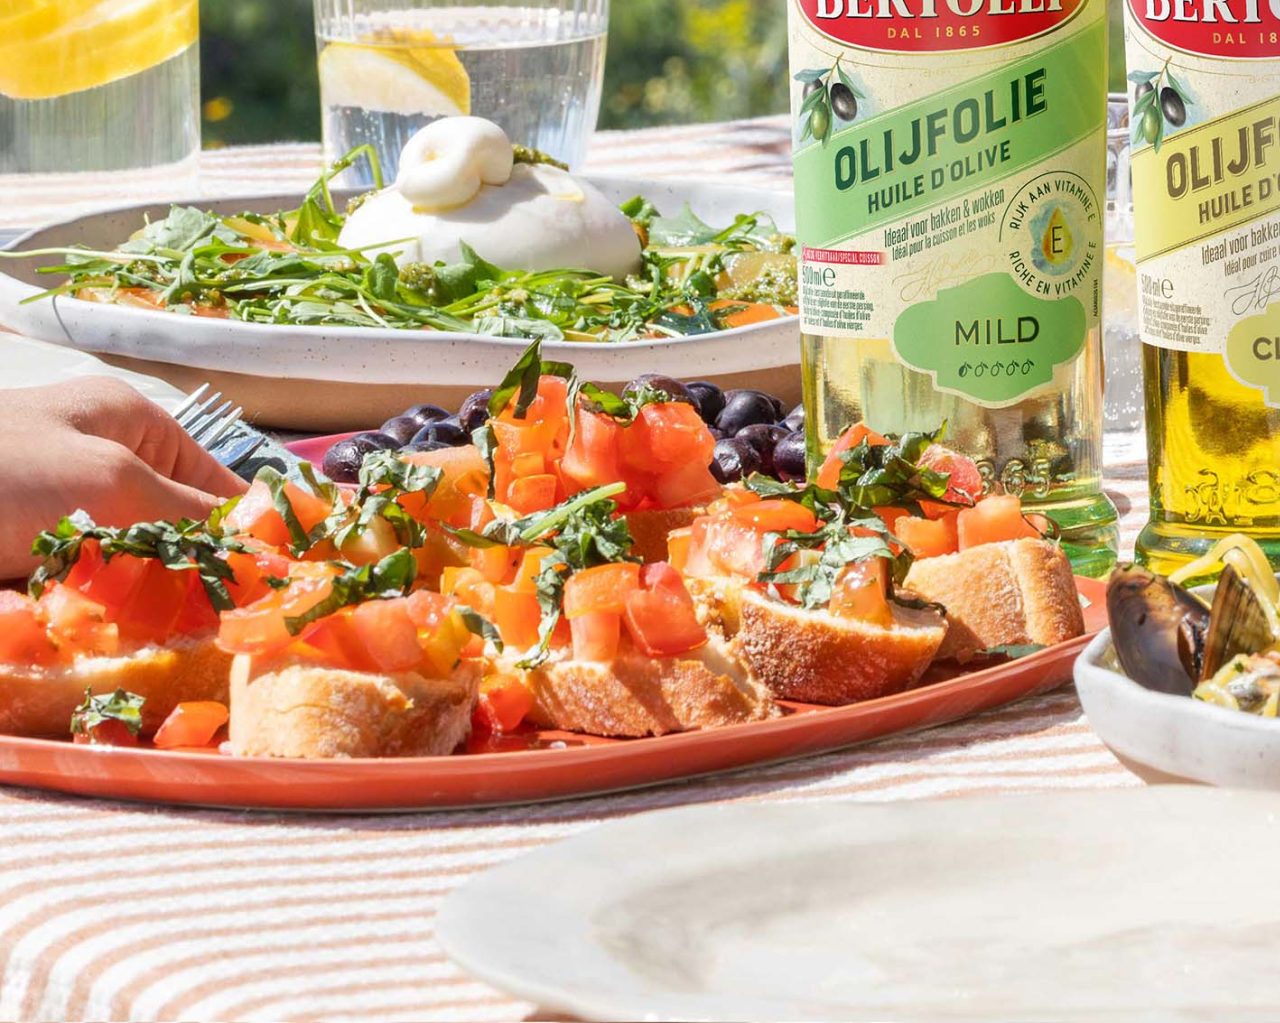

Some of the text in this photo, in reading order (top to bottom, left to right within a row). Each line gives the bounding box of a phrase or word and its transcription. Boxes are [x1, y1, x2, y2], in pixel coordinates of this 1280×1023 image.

[887, 25, 981, 39] DAL 1865
[1212, 32, 1247, 45] DAL
[834, 67, 1047, 191] OLIJFOLIE
[868, 140, 1011, 214] HUILE D'OLIVE
[884, 223, 909, 248] Ideaal
[910, 218, 929, 238] voor
[930, 206, 961, 231] bakken
[972, 188, 1005, 215] wokken
[1009, 201, 1029, 230] RIJK
[1028, 182, 1052, 203] AAN
[1054, 179, 1092, 213] VITAMINE
[1198, 184, 1253, 225] HUILE
[909, 239, 925, 256] pour
[978, 211, 996, 228] woks
[1052, 225, 1063, 254] E
[1201, 238, 1227, 265] Ideaal
[1229, 233, 1249, 255] voor
[1009, 250, 1036, 287] RICHE
[1036, 280, 1051, 295] EN
[1054, 252, 1095, 296] VITAMINE
[1242, 253, 1257, 271] pour
[1259, 245, 1277, 264] cuire
[955, 316, 1040, 346] MILD
